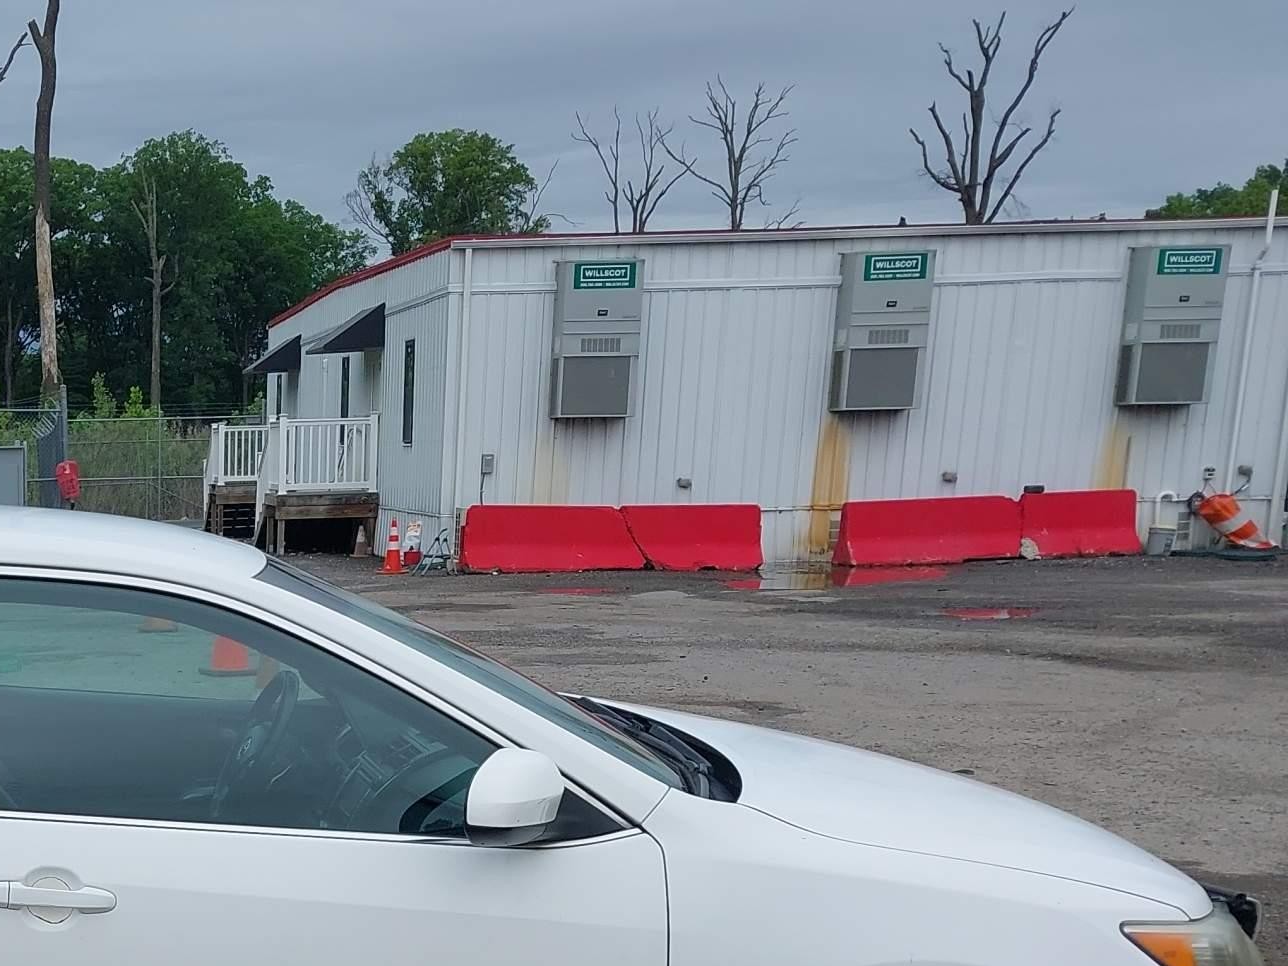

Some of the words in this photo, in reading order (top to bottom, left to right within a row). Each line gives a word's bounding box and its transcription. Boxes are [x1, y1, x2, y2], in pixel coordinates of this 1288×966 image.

[1169, 255, 1212, 263] WILLSCOT
[875, 260, 917, 269] WILLSCOT
[585, 269, 626, 277] WILLSCOT
